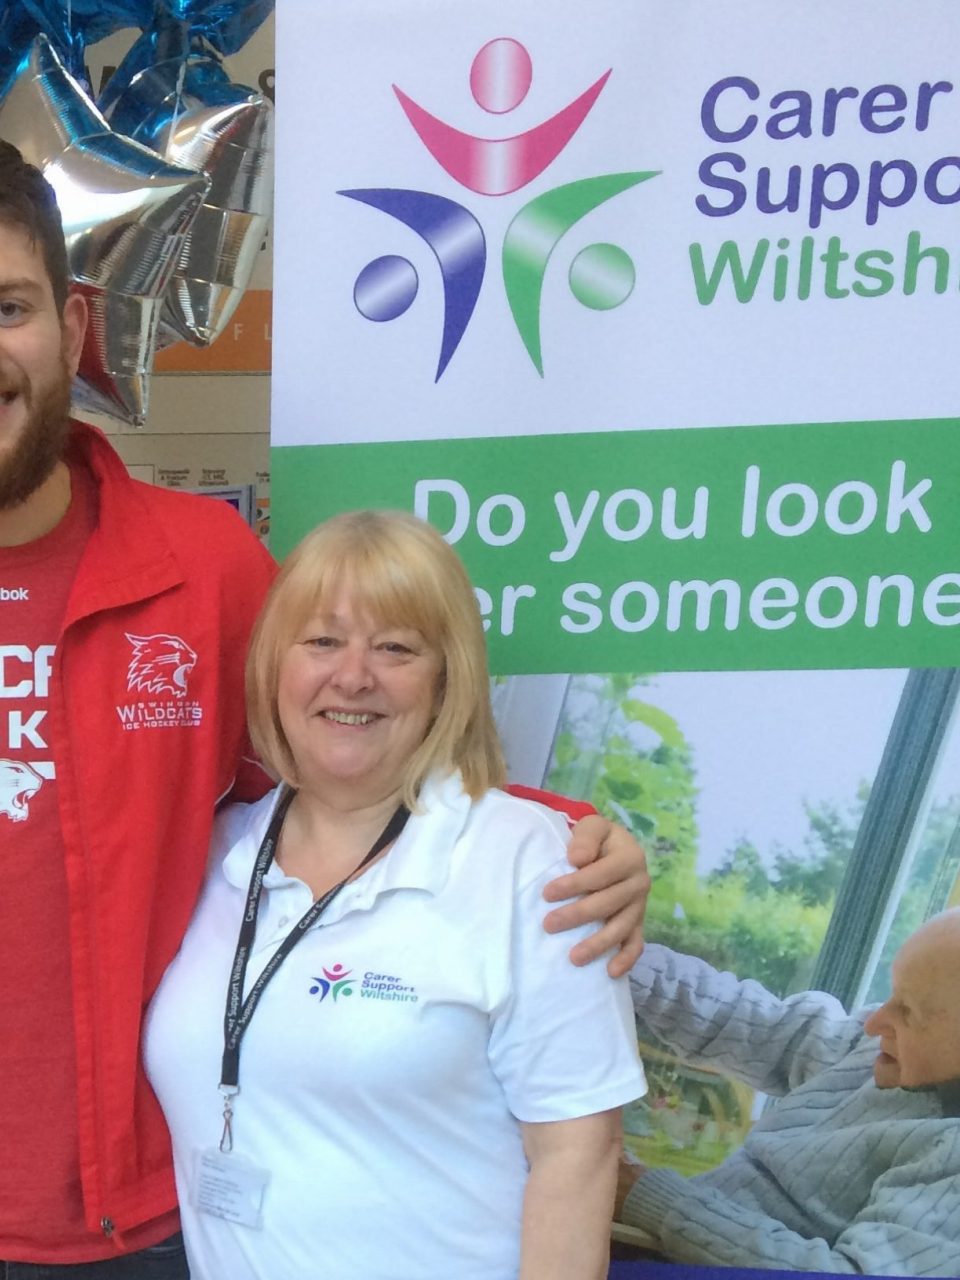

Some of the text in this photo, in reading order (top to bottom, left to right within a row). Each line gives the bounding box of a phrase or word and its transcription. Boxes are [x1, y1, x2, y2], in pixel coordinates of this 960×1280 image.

[700, 75, 954, 143] Carer
[688, 230, 960, 306] Wiltsh
[414, 460, 933, 562] Do you look
[560, 572, 960, 635] someone
[360, 989, 418, 1002] Wiltshire
[361, 979, 415, 992] Support
[364, 971, 402, 983] Carer
